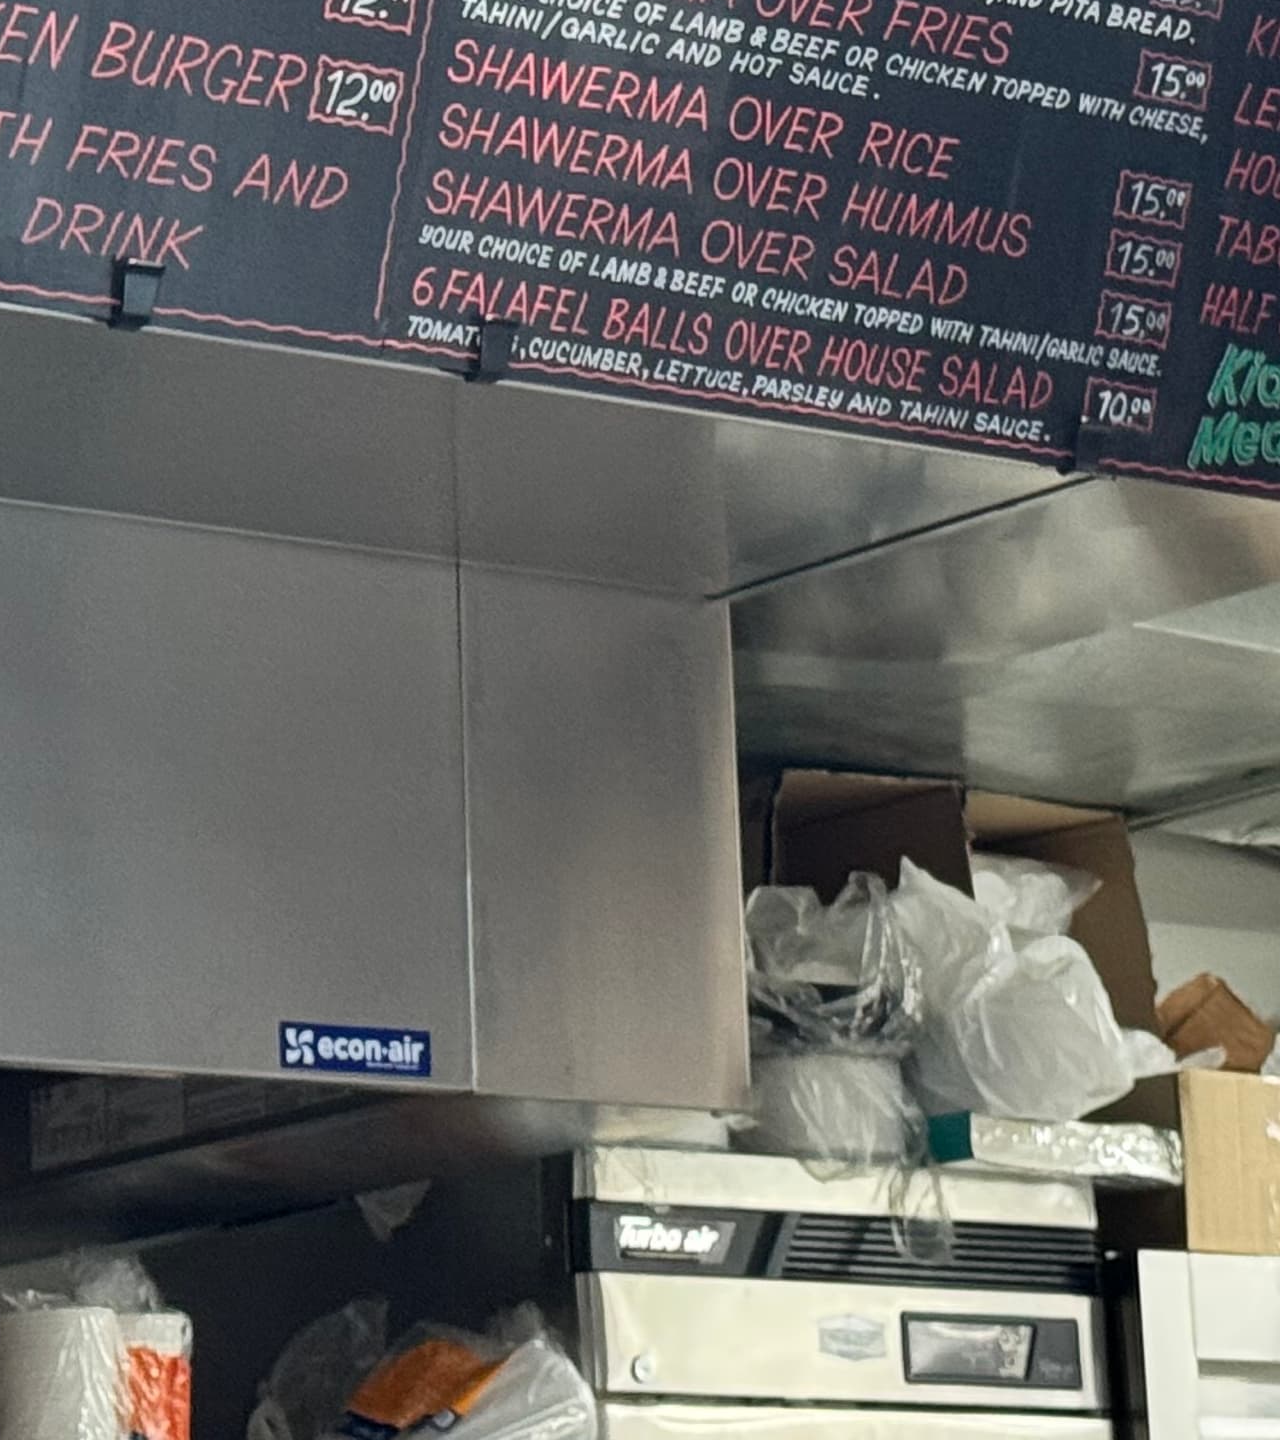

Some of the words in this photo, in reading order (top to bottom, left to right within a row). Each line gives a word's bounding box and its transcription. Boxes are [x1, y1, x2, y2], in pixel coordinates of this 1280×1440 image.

[90, 20, 309, 113] BURGER
[65, 123, 218, 193] FRIES
[232, 152, 350, 210] AND
[20, 195, 205, 271] DRINK
